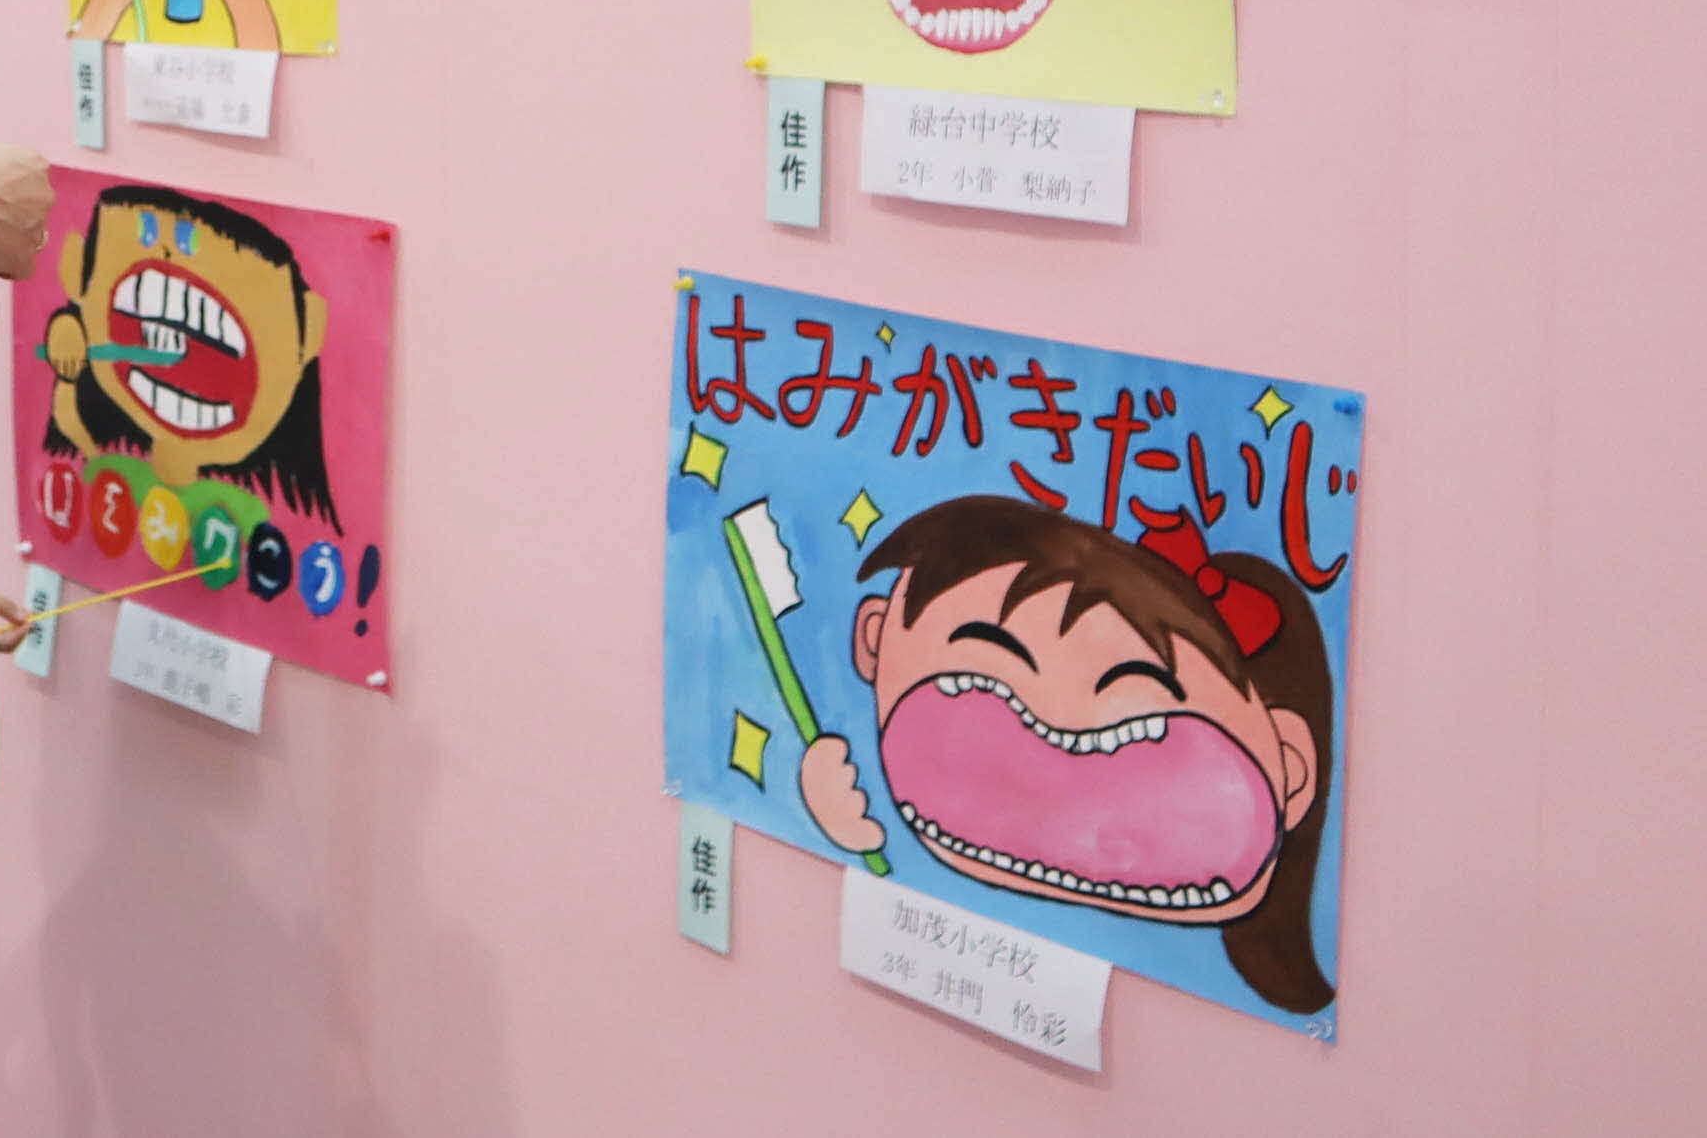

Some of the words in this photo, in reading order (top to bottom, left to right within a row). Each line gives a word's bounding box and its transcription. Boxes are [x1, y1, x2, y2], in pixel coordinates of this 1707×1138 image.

[780, 109, 808, 193] 佳作
[908, 104, 1061, 150] 緑台中学校
[898, 160, 934, 189] 2年
[685, 293, 1358, 592] はみがきだいじ
[691, 834, 718, 916] 佳作
[893, 896, 1041, 985] 加茂小学校
